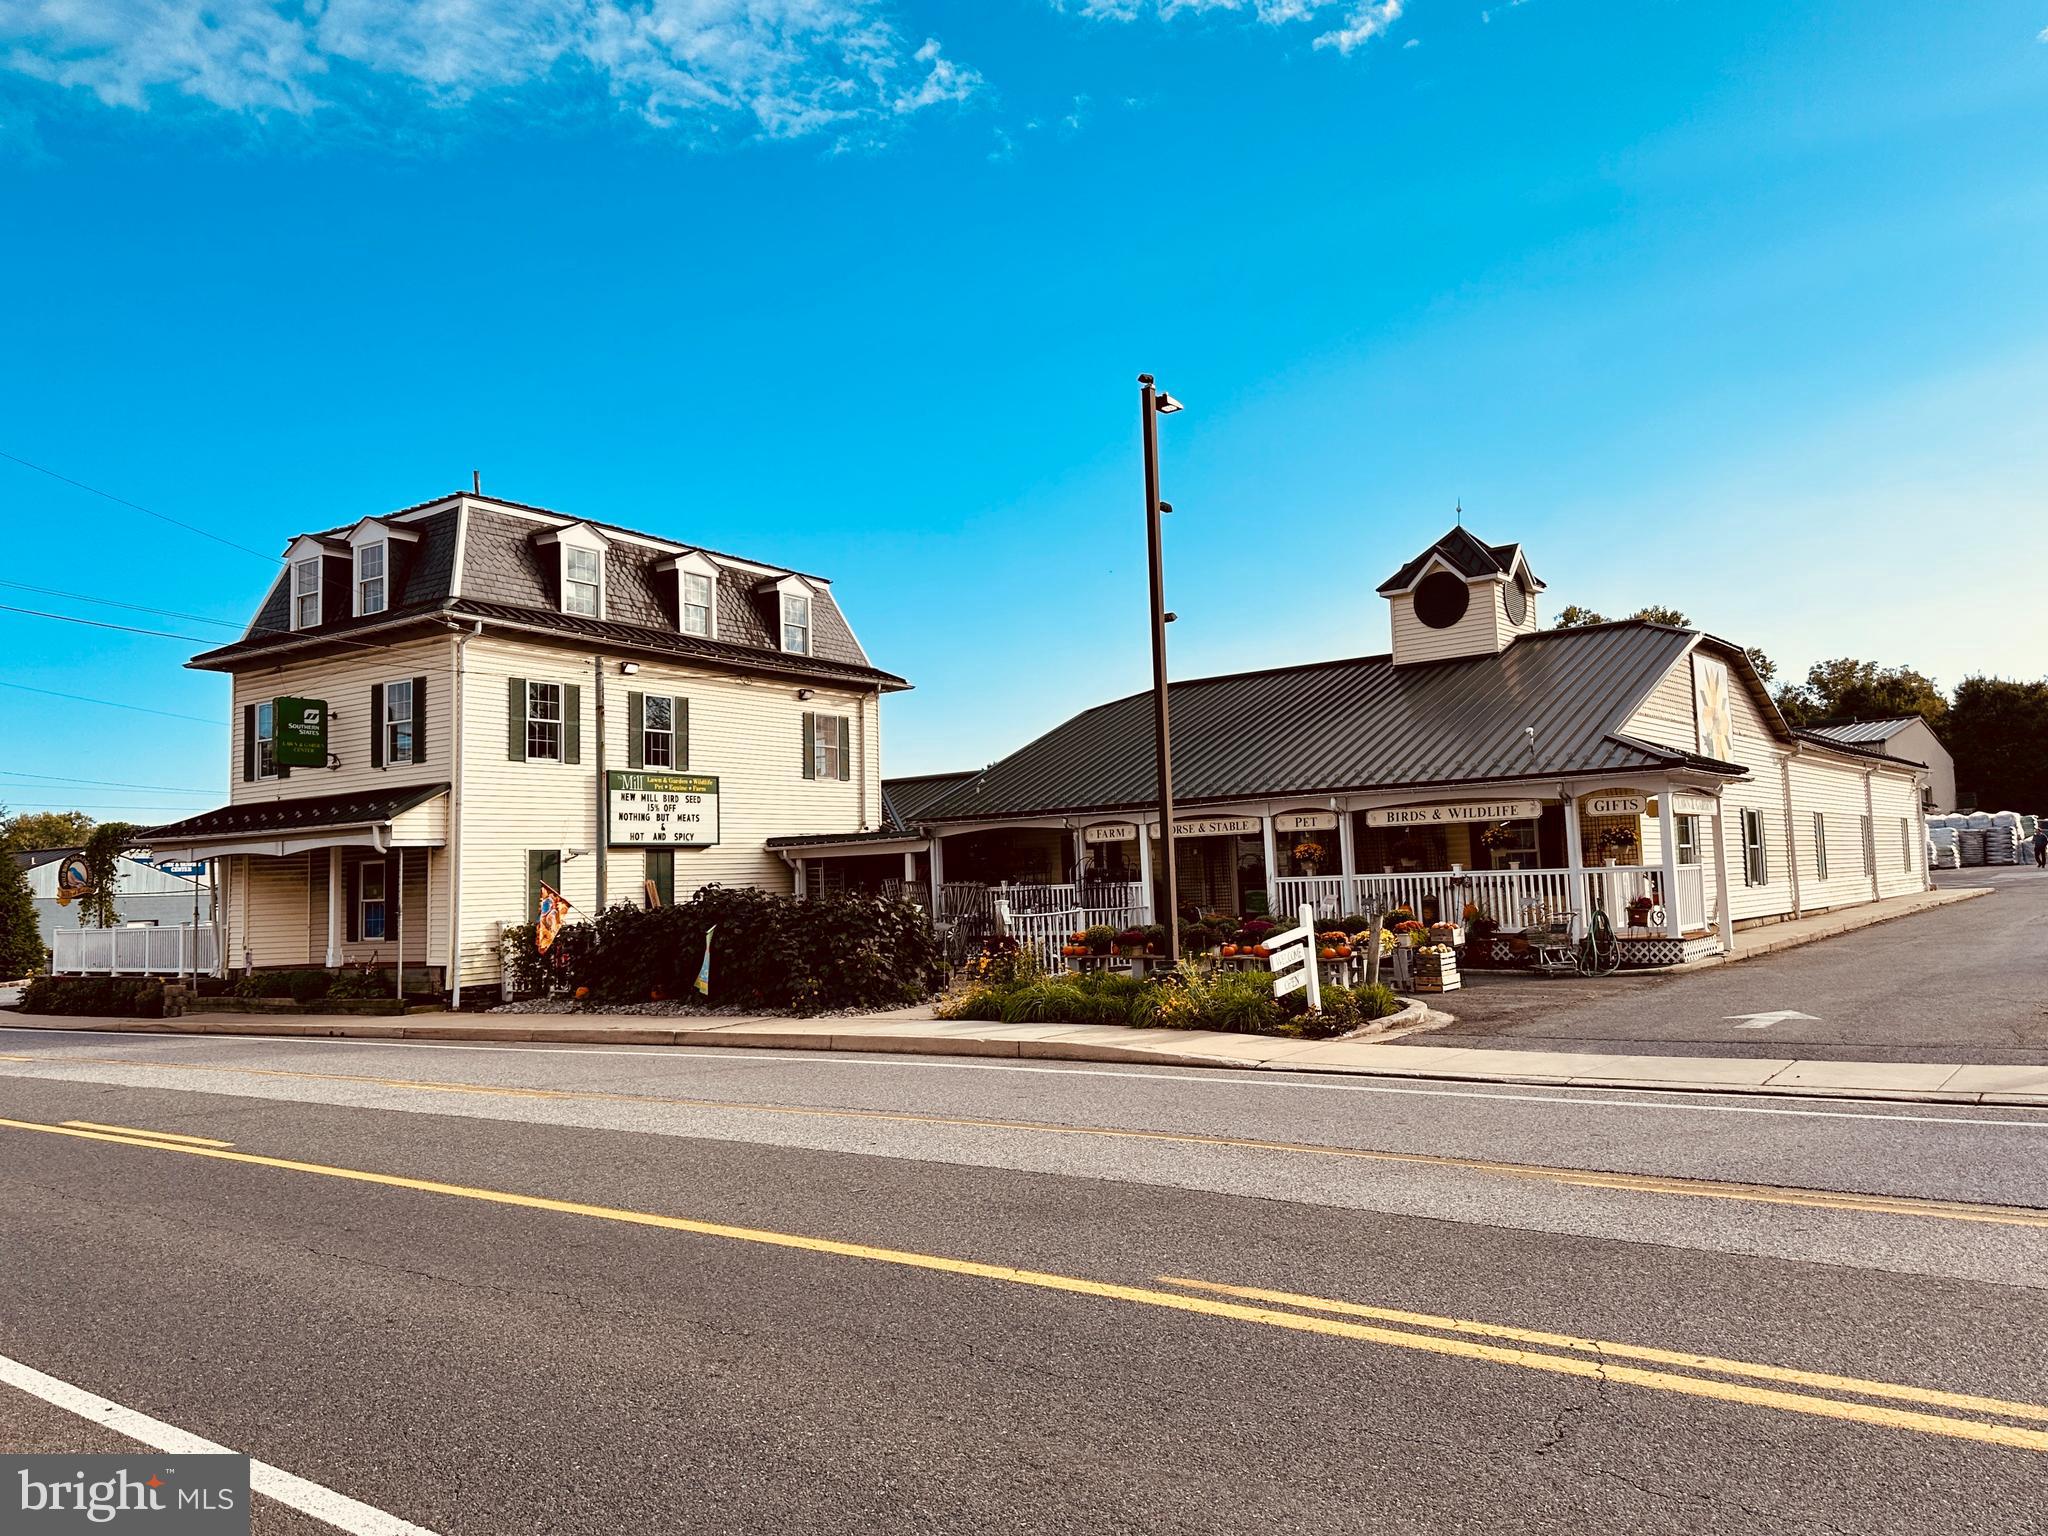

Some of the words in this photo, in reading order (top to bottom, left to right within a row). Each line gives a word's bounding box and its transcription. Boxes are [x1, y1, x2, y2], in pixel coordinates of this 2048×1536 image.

[621, 775, 644, 790] Mill
[621, 793, 636, 801] NEW
[1594, 799, 1638, 811] GIFTS
[619, 813, 650, 821] NOTHING
[677, 814, 700, 822] MEATS
[1387, 810, 1426, 823] BIRDS
[1432, 809, 1441, 820] &
[1448, 805, 1519, 819] WILDLIFE
[1198, 823, 1206, 832] &
[1209, 821, 1249, 832] STABLE
[1295, 817, 1317, 827] PET
[674, 833, 694, 841] SPICY
[1097, 828, 1125, 839] FARM
[1276, 948, 1303, 967] WELCOME
